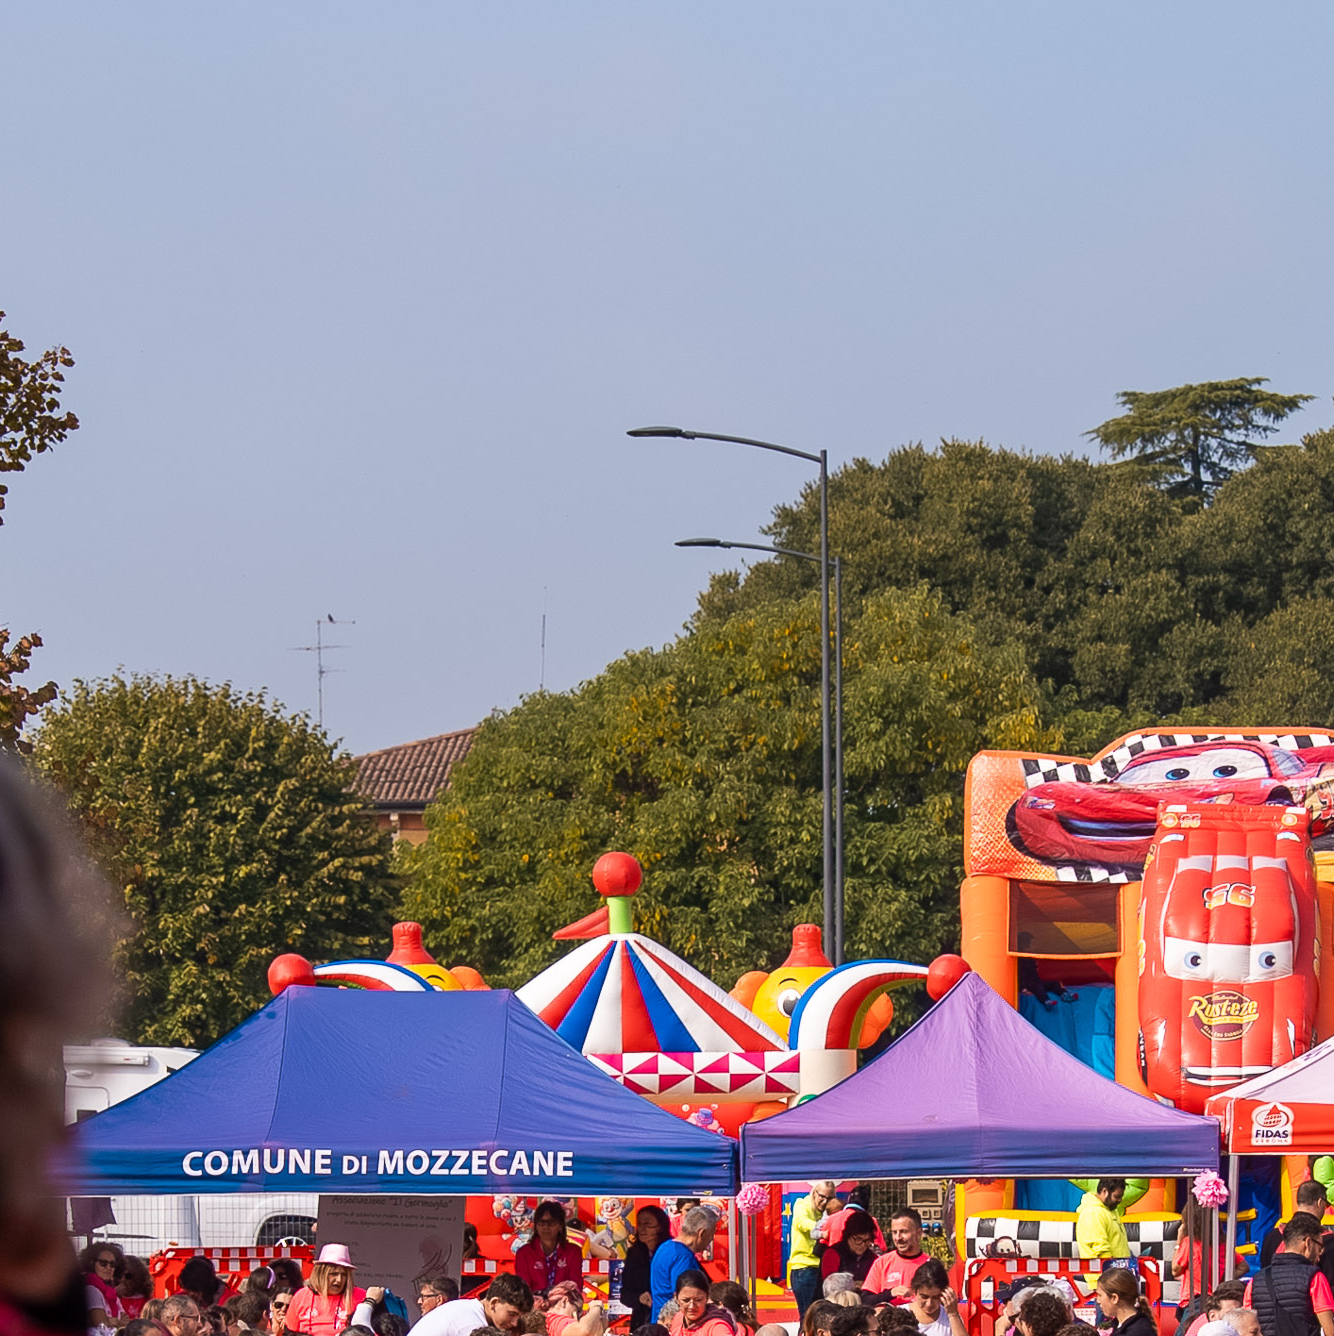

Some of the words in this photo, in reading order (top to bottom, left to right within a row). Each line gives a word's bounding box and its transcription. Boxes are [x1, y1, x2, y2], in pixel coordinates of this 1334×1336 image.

[1255, 1130, 1289, 1138] FIDAS
[182, 1148, 332, 1176] COMUNE
[376, 1149, 573, 1177] MOZZECANE
